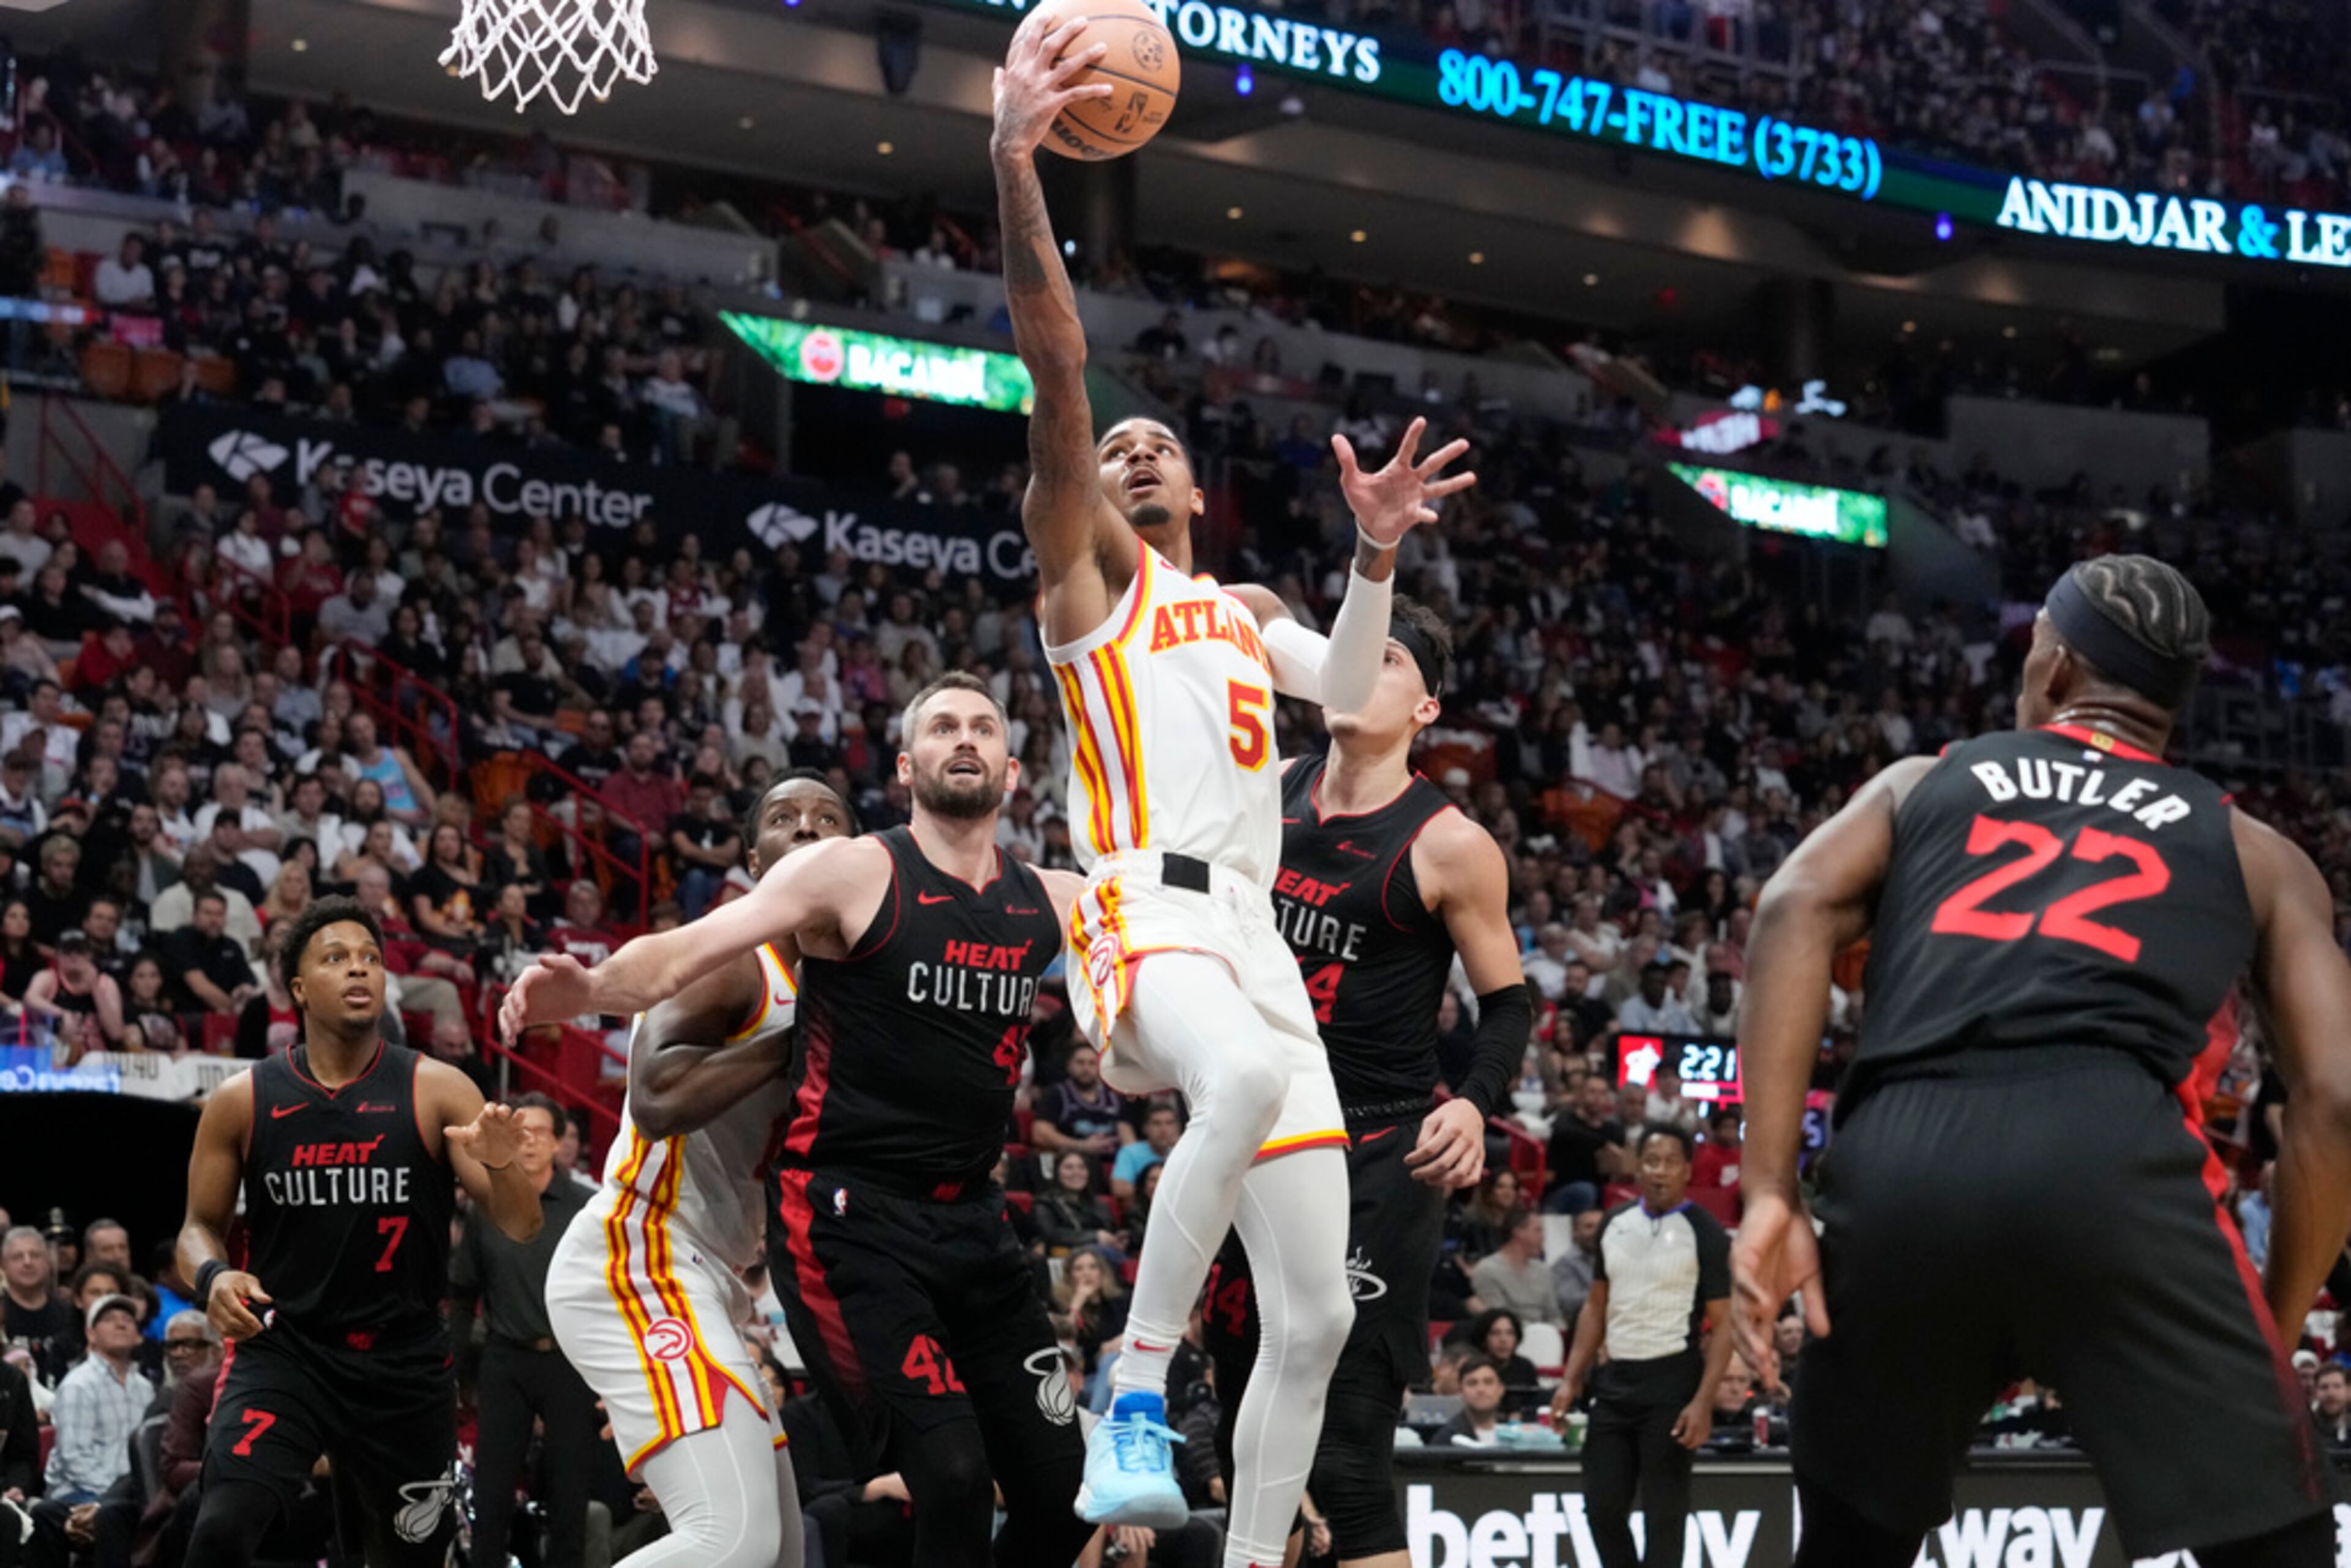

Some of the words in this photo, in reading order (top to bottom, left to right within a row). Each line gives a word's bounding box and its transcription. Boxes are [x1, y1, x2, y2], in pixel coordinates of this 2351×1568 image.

[1144, 0, 1380, 83] TORNEYS
[1438, 48, 1748, 166] 800-747-FREE
[1753, 115, 1882, 200] (3733)
[1997, 177, 2233, 253] ANIDJAR
[2237, 204, 2280, 258] &
[2285, 210, 2351, 266] LE
[482, 462, 653, 529] Center
[825, 511, 980, 575] Kaseya
[1149, 599, 1272, 677] ATLAN
[1227, 677, 1270, 773] 5
[1970, 757, 2191, 831] BUTLER
[1930, 812, 2171, 964] 22
[943, 938, 1033, 971] HEAT
[1278, 898, 1367, 961] TURE
[1296, 956, 1344, 1024] 4
[291, 1133, 385, 1167] HEAT
[264, 1167, 410, 1206] CULTURE
[375, 1216, 409, 1272] 7
[232, 1409, 276, 1456] 7
